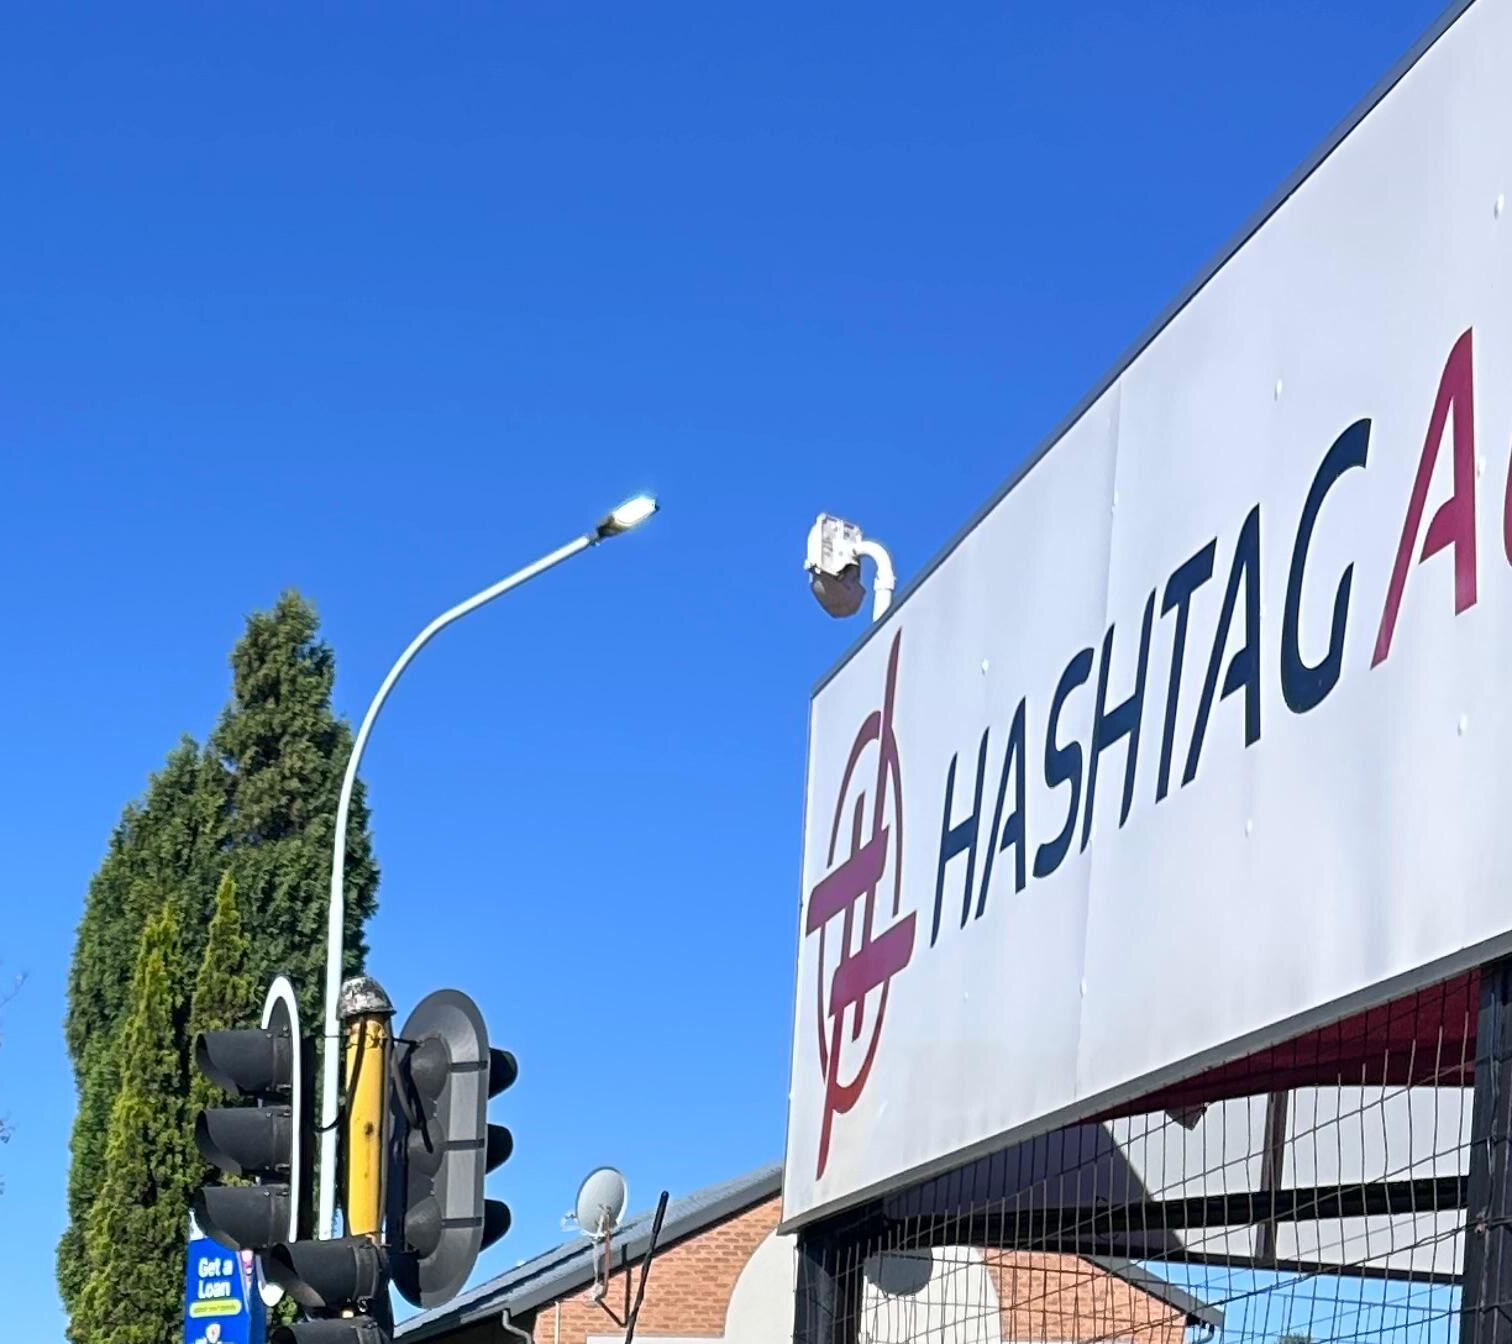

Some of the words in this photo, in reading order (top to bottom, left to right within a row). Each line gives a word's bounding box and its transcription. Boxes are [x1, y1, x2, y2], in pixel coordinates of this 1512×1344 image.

[198, 1257, 221, 1278] Get
[222, 1259, 233, 1276] a
[198, 1280, 231, 1299] Loan
